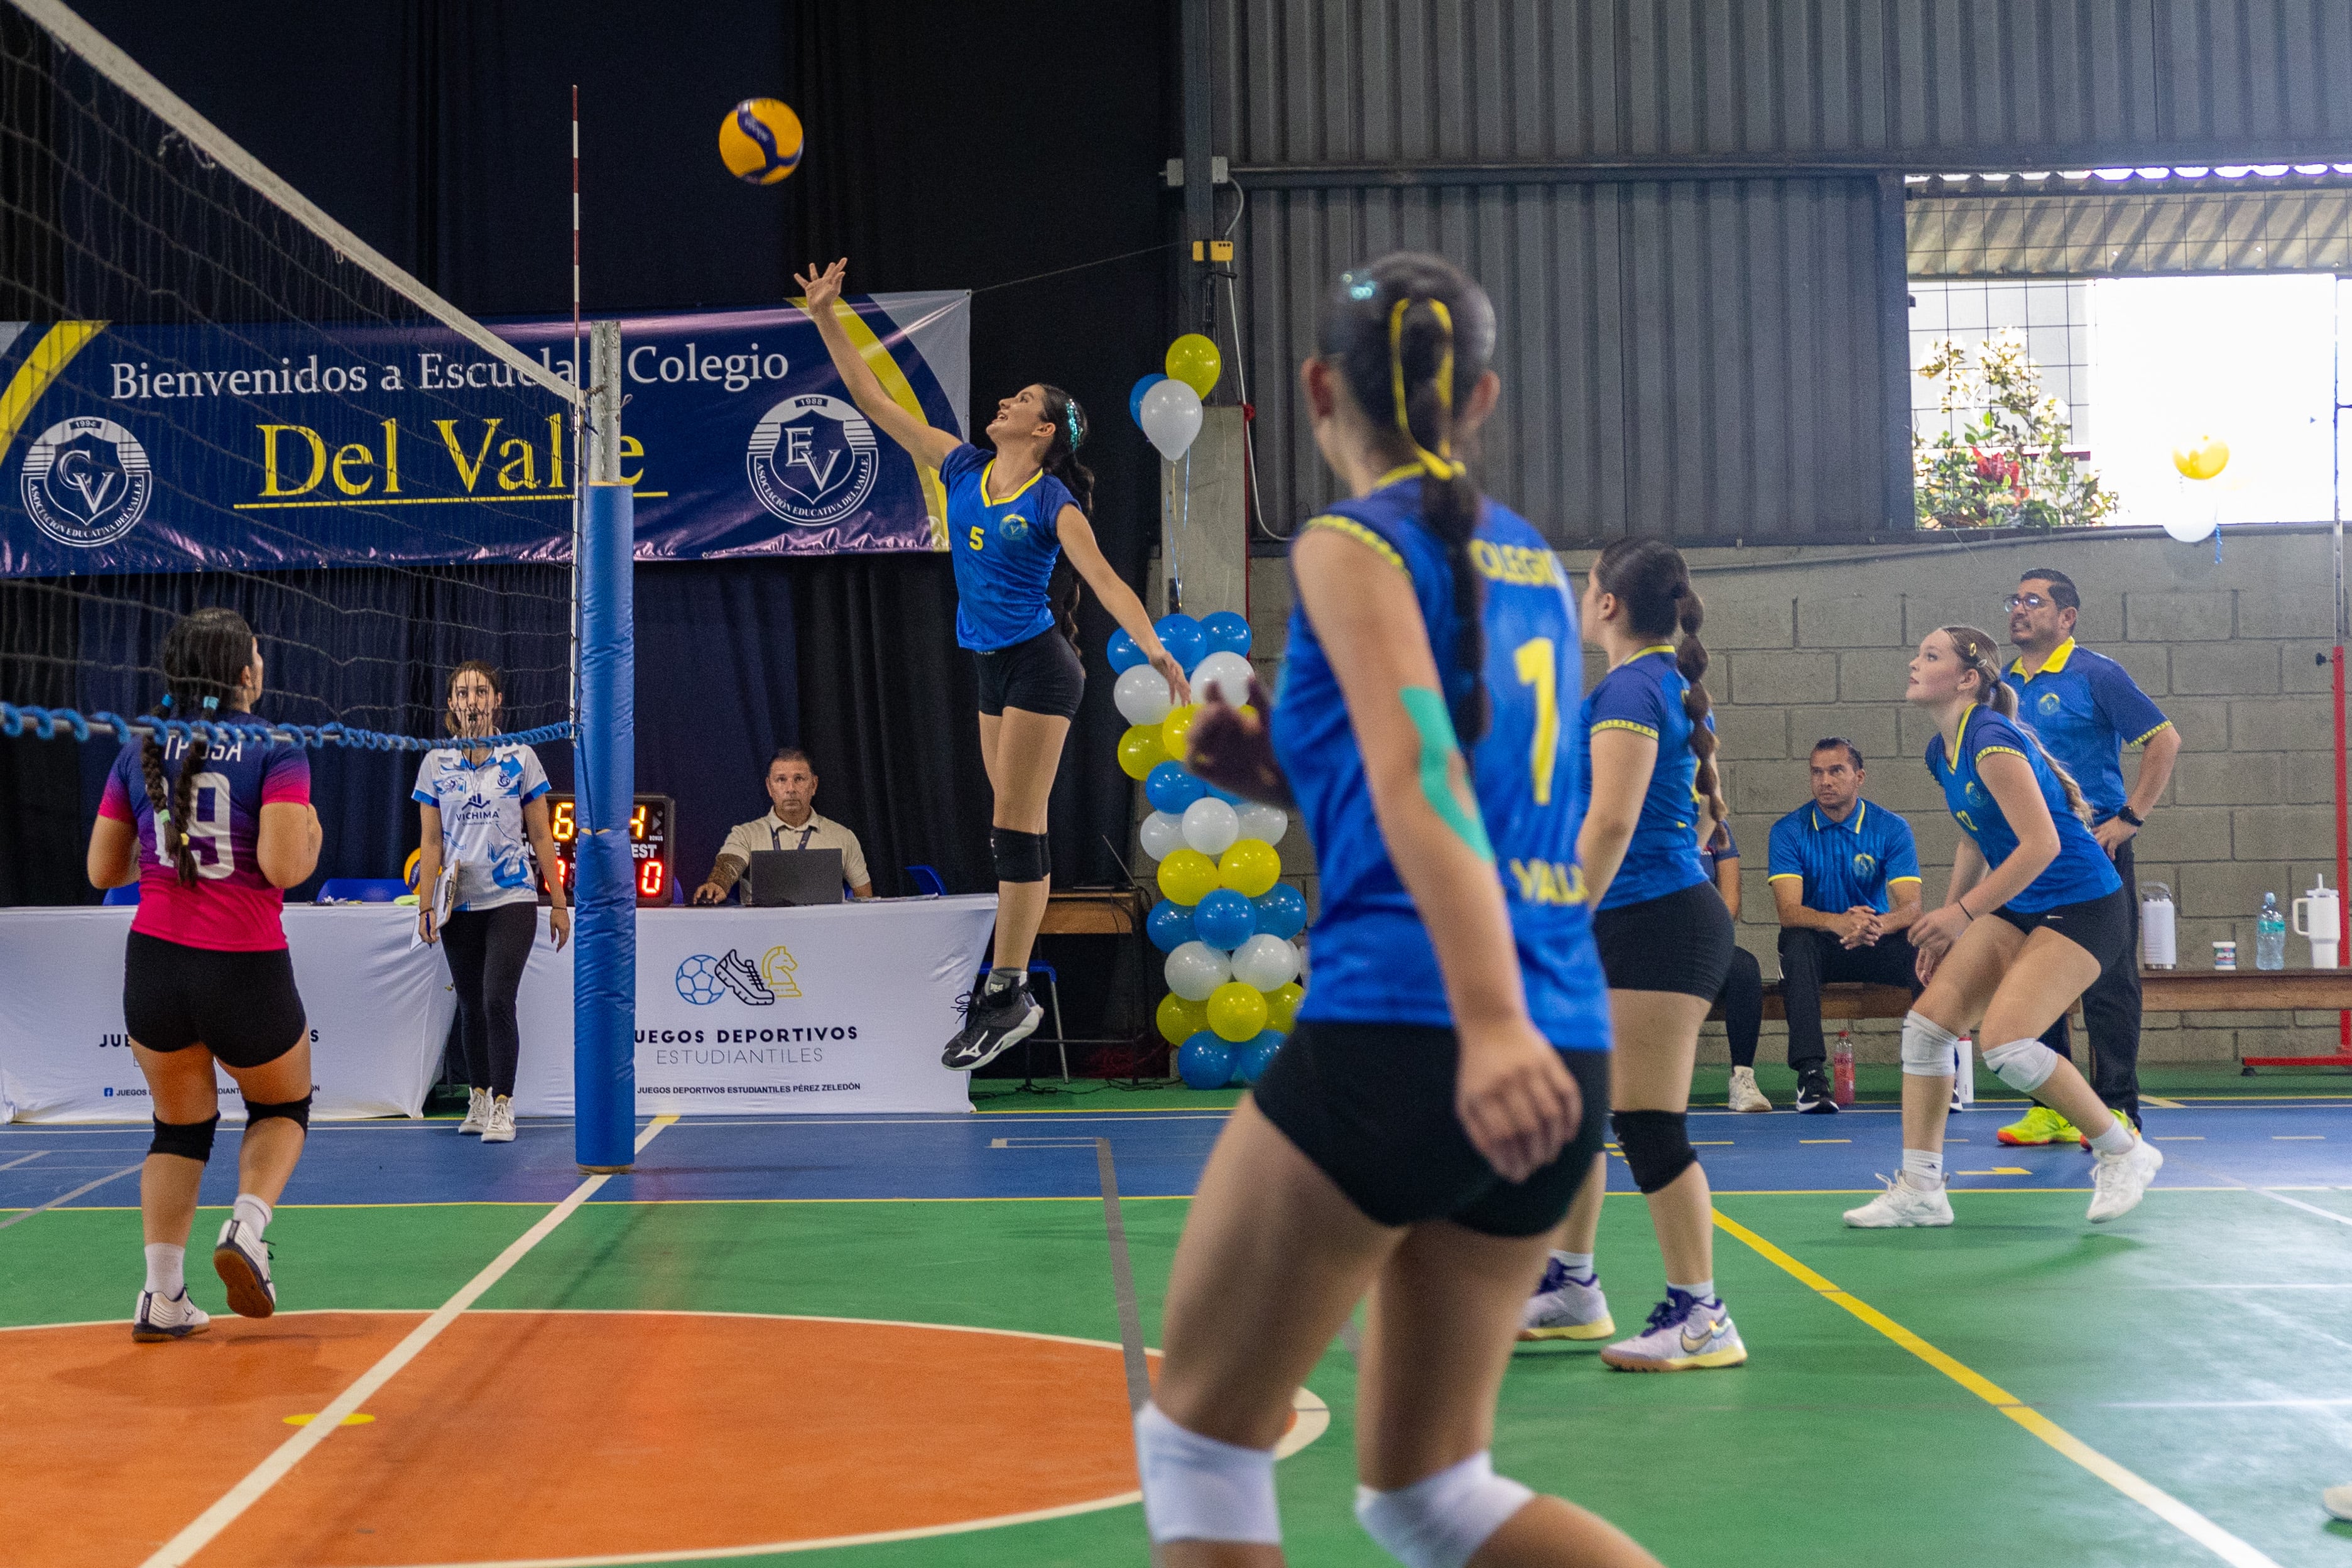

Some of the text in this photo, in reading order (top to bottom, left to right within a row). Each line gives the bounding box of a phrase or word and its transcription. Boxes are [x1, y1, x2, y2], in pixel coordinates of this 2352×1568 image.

[111, 354, 368, 399] Bienvenidos
[381, 364, 403, 391] a
[628, 342, 789, 393] Colegio
[256, 412, 645, 497] Del Vale
[785, 426, 841, 492] EV
[57, 449, 115, 514] CV
[793, 503, 842, 517] EDUCATIVA
[842, 491, 858, 506] DEL
[854, 458, 869, 492] VALLE
[969, 526, 984, 551] 5
[1513, 636, 1557, 806] 1
[455, 811, 499, 821] VICHIMA
[553, 802, 575, 840] 6
[631, 844, 657, 858] EST
[641, 860, 663, 894] 0
[634, 1026, 858, 1043] UEGOS DEPORTIVOS
[656, 1047, 824, 1064] ESTUDIANTILES
[673, 1086, 726, 1094] DEPORTIVOS
[727, 1085, 791, 1093] ESTUDIANTILES
[793, 1082, 820, 1092] PÉREZ
[822, 1082, 861, 1092] ZELEDÓN
